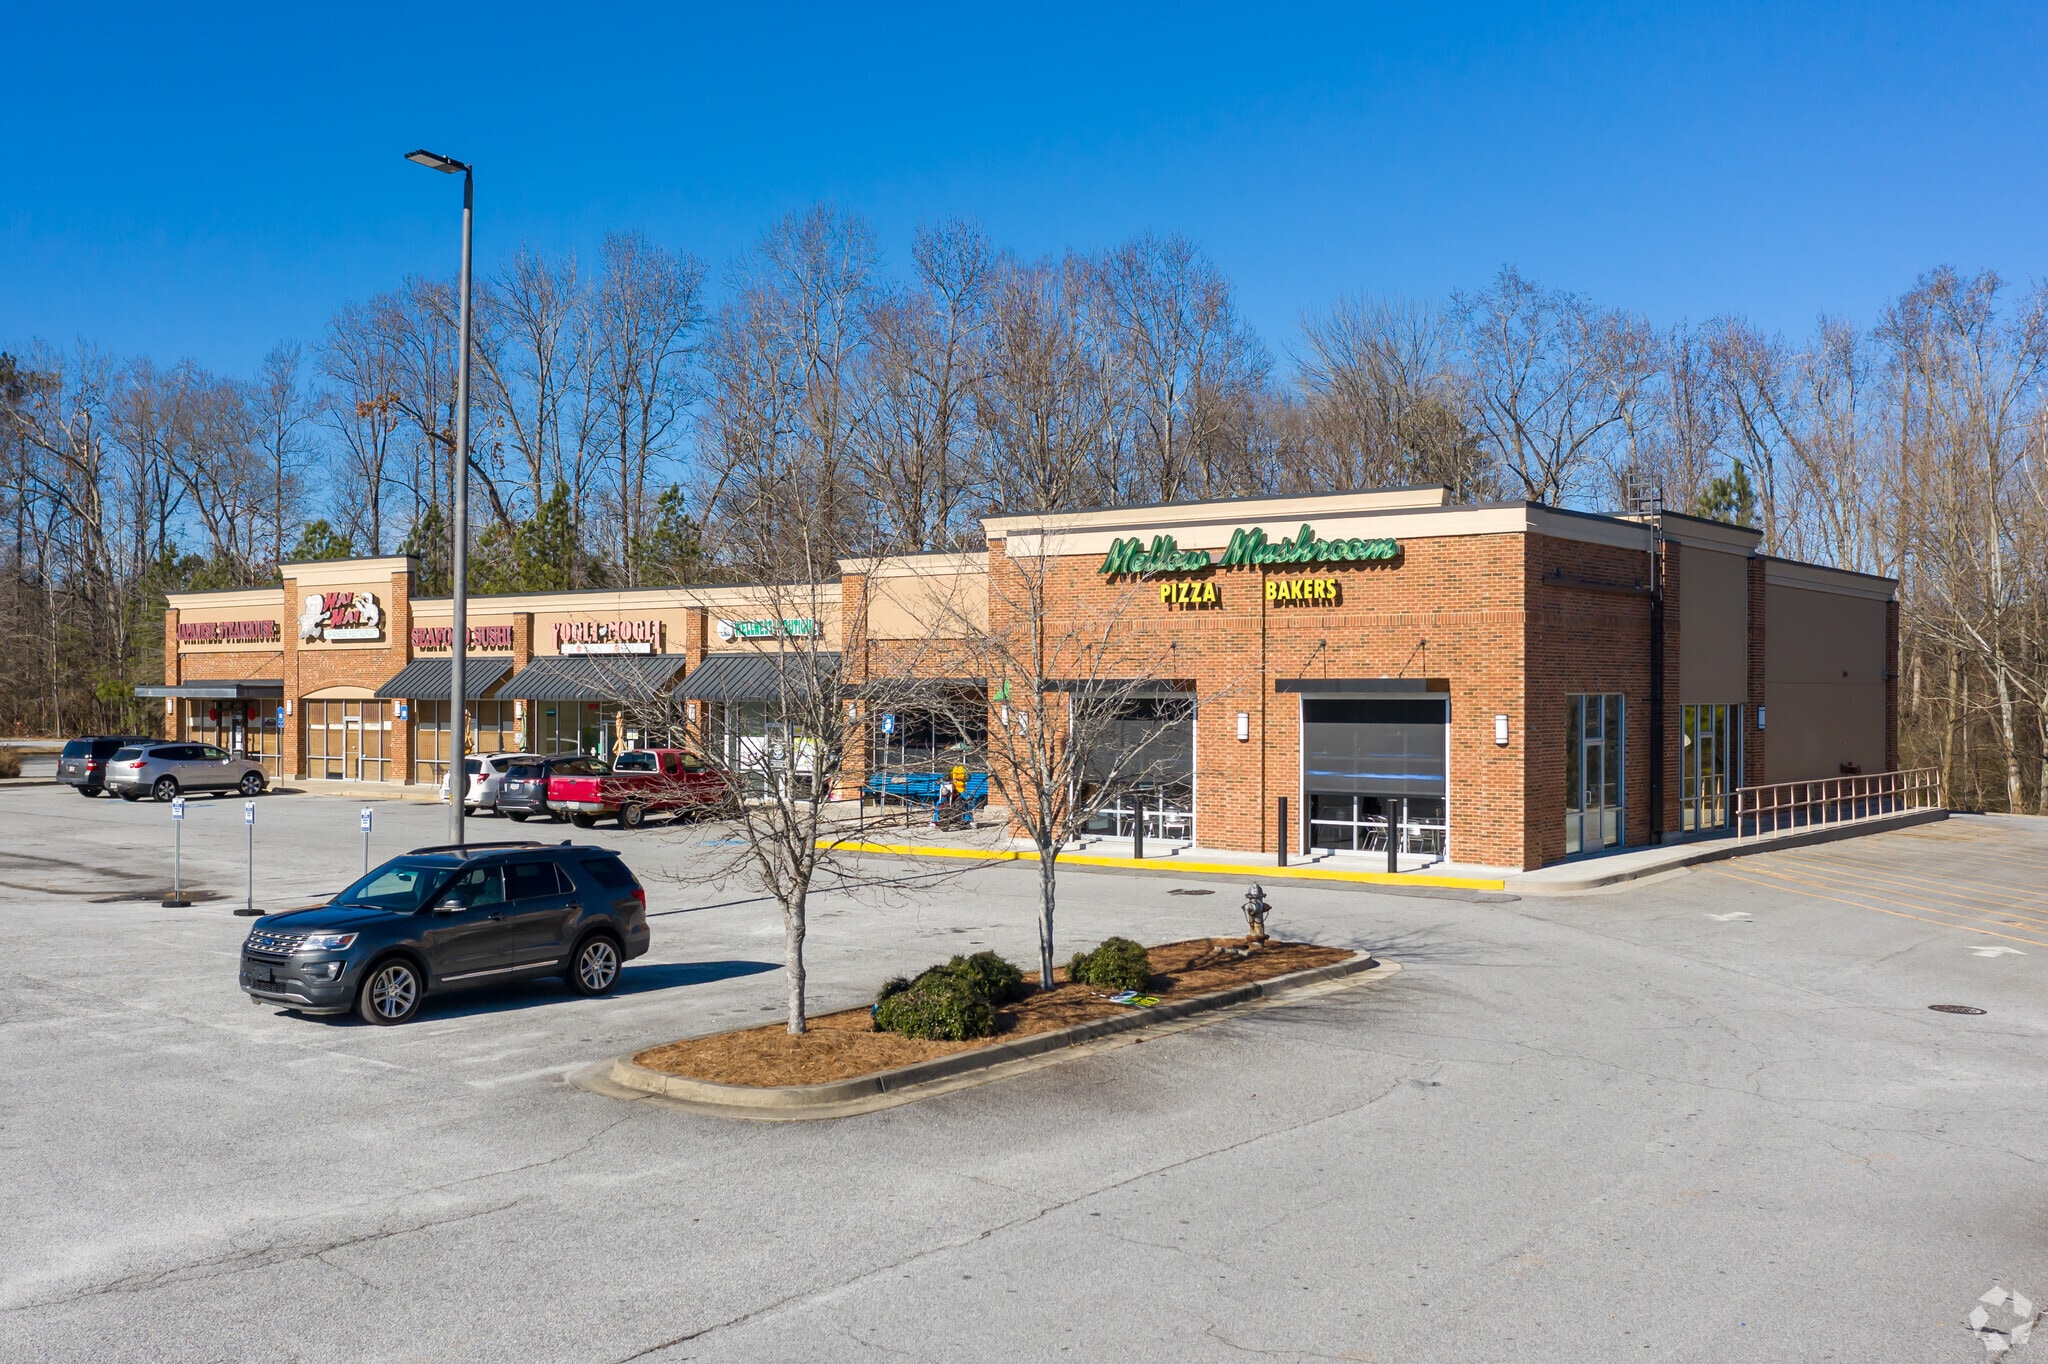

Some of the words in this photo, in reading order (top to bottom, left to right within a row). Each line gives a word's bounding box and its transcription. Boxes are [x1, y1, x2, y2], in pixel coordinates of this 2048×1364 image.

[1097, 534, 1211, 575] Mellow
[1216, 523, 1400, 567] Mushroom
[1160, 582, 1216, 603] PIZZA
[1265, 578, 1337, 600] BAKERS
[177, 623, 216, 640] JAPANESE
[218, 620, 275, 639] STEAKHOUSE
[411, 627, 471, 647] SEAFO
[474, 625, 512, 646] SUSHI
[550, 622, 598, 650] YOGLI
[607, 620, 661, 649] MOGLI
